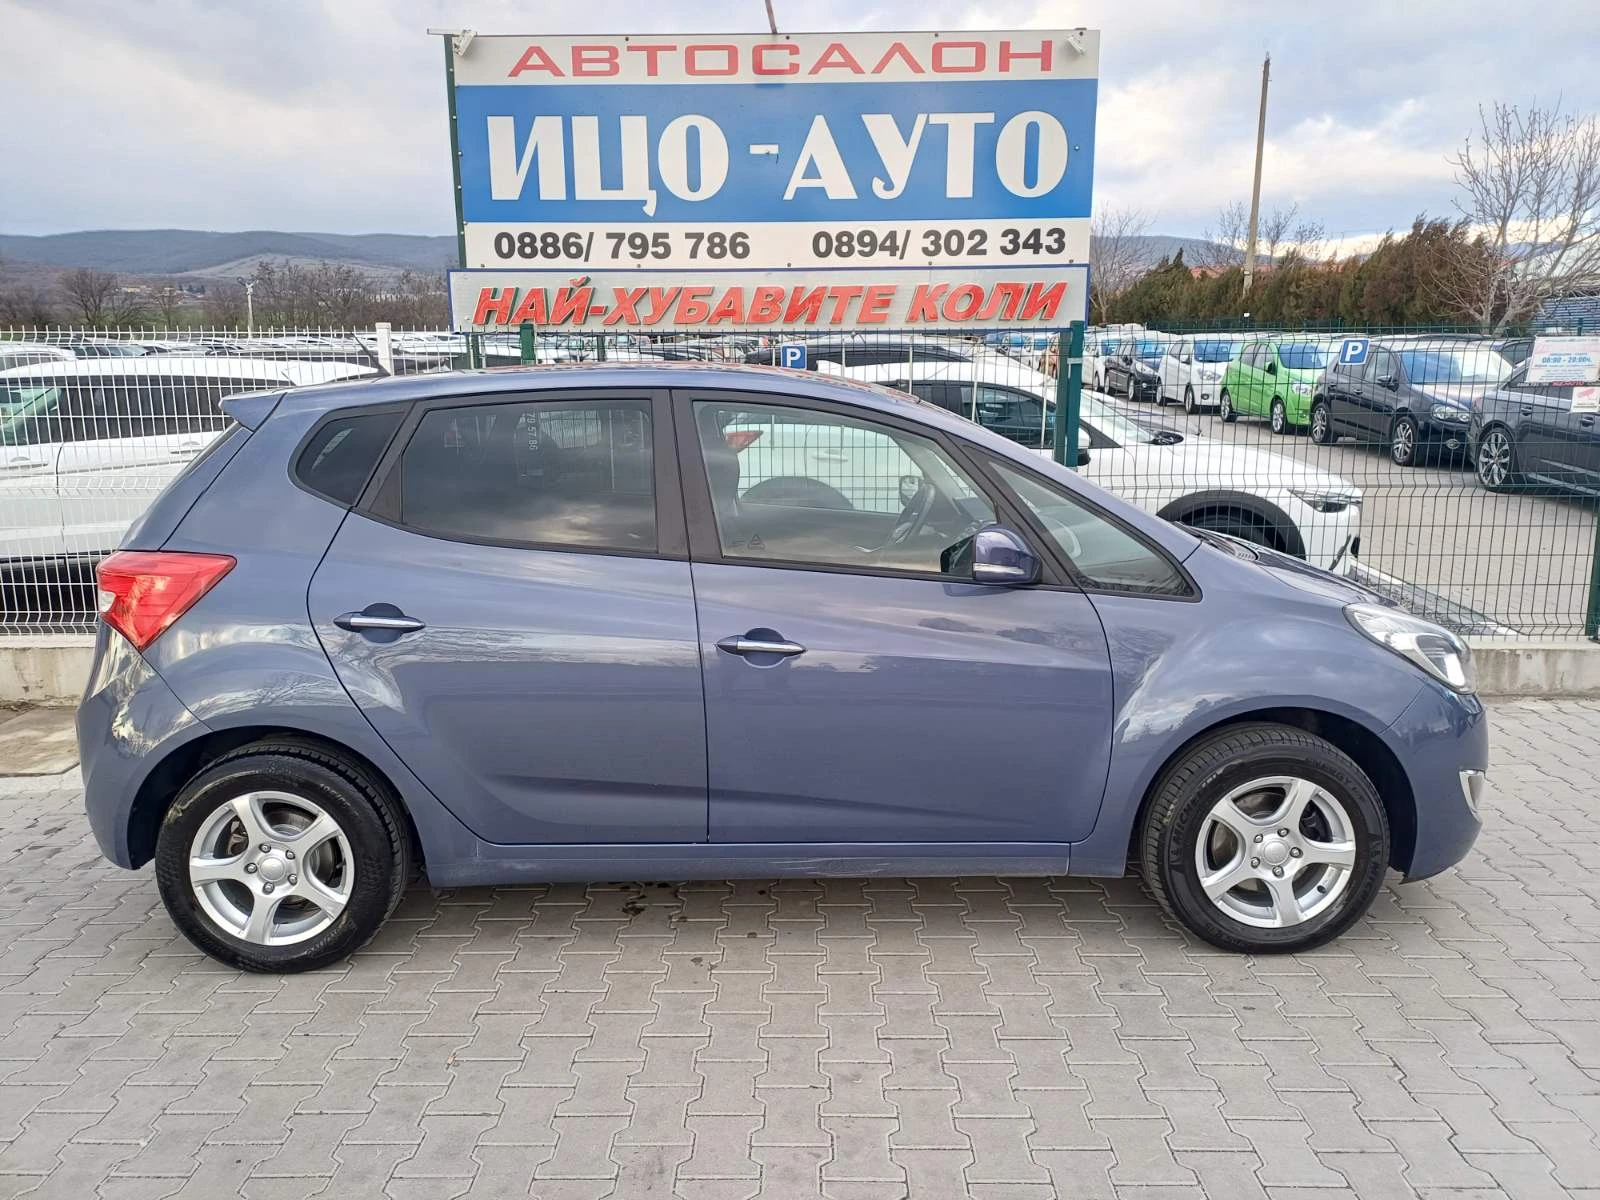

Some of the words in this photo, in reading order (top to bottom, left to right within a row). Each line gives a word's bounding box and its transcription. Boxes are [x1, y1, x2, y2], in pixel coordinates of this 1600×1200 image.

[507, 40, 1053, 78] АВТОСАЛОН
[494, 231, 594, 262] 0886/
[605, 231, 672, 260] 795
[684, 231, 750, 260] 786
[812, 229, 911, 260] 0894/
[921, 228, 988, 257] 302
[999, 227, 1066, 255] 343
[472, 275, 899, 326] НАЙ-ХУБАВИТЕ
[905, 281, 1069, 323] КОЛИ
[786, 348, 801, 367] P
[1345, 341, 1363, 362] P
